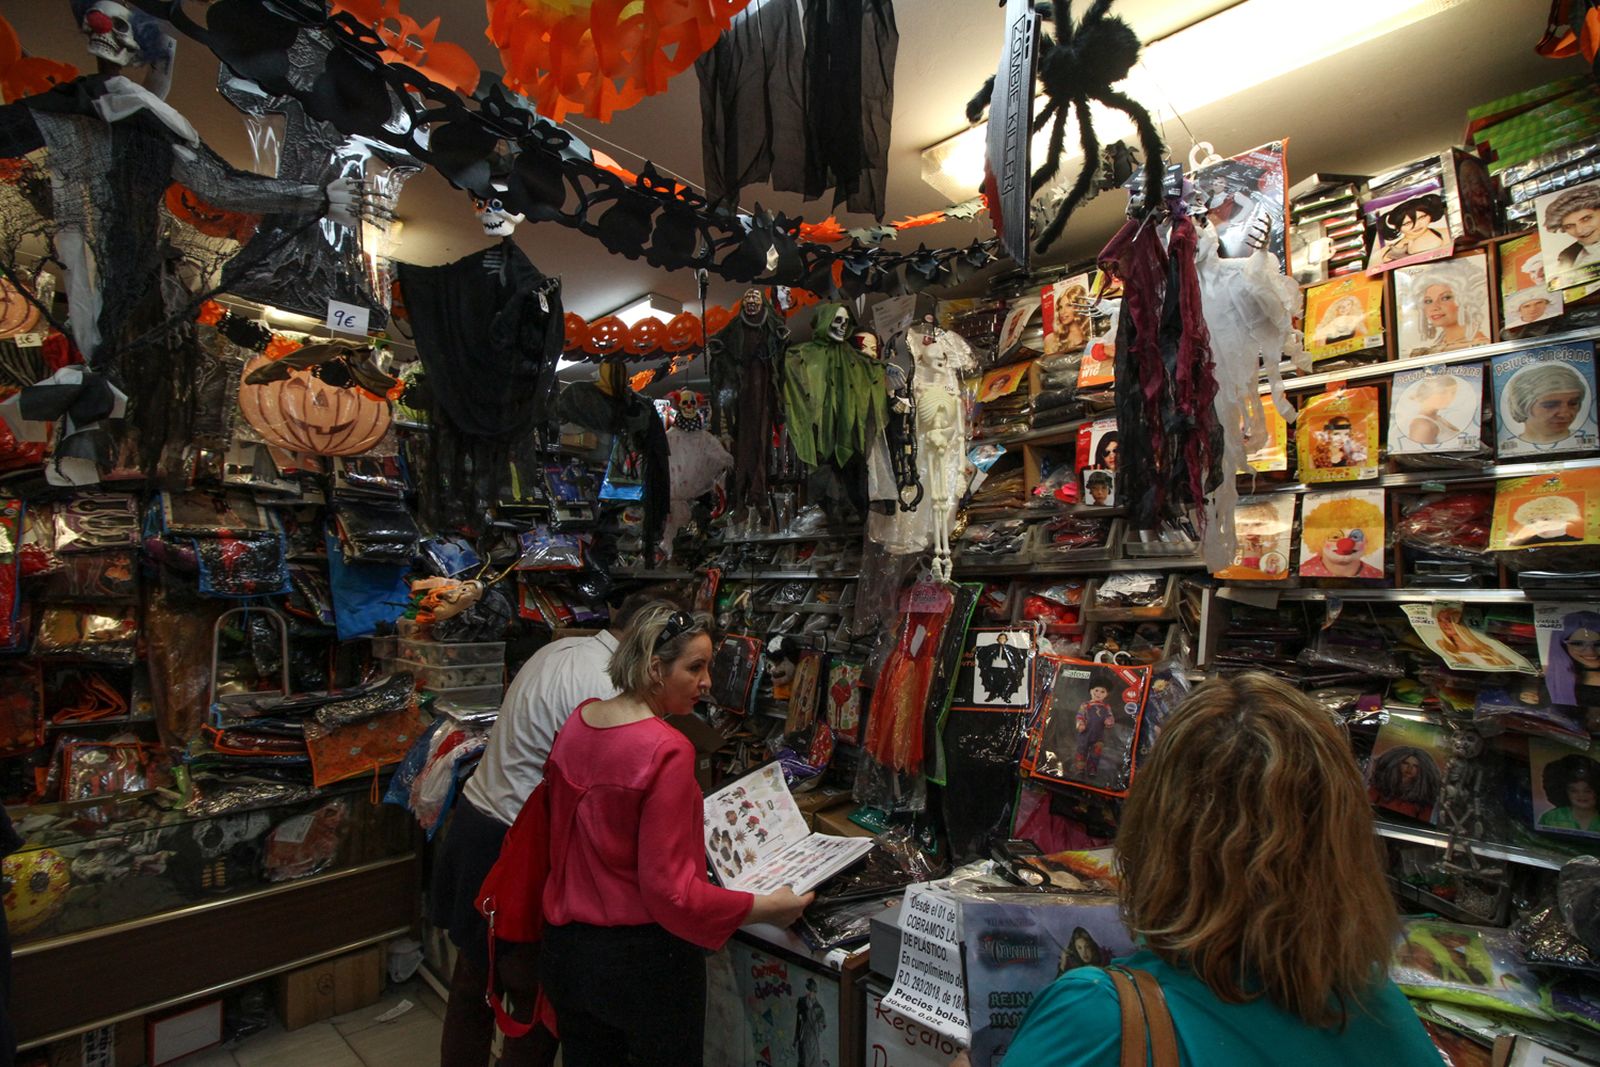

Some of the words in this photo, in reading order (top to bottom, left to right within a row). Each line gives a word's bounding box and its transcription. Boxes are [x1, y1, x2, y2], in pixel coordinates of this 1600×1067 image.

[1009, 24, 1024, 106] ZOMBIE
[1003, 113, 1018, 190] KILLER
[333, 310, 356, 328] 9€
[1082, 367, 1100, 378] WIG
[910, 895, 930, 914] Desde
[931, 904, 939, 916] el
[938, 905, 946, 920] 01
[947, 908, 956, 923] de
[907, 914, 946, 940] COBRAMOS
[904, 932, 913, 947] DE
[913, 936, 949, 962] PLÁSTICO.
[901, 950, 910, 966] En
[911, 958, 955, 984] cumplimiento
[894, 988, 934, 1012] Precios
[897, 969, 911, 987] R.D.
[911, 976, 941, 1001] 293/2018,
[942, 990, 952, 1005] de
[917, 1012, 944, 1027] 0.02€
